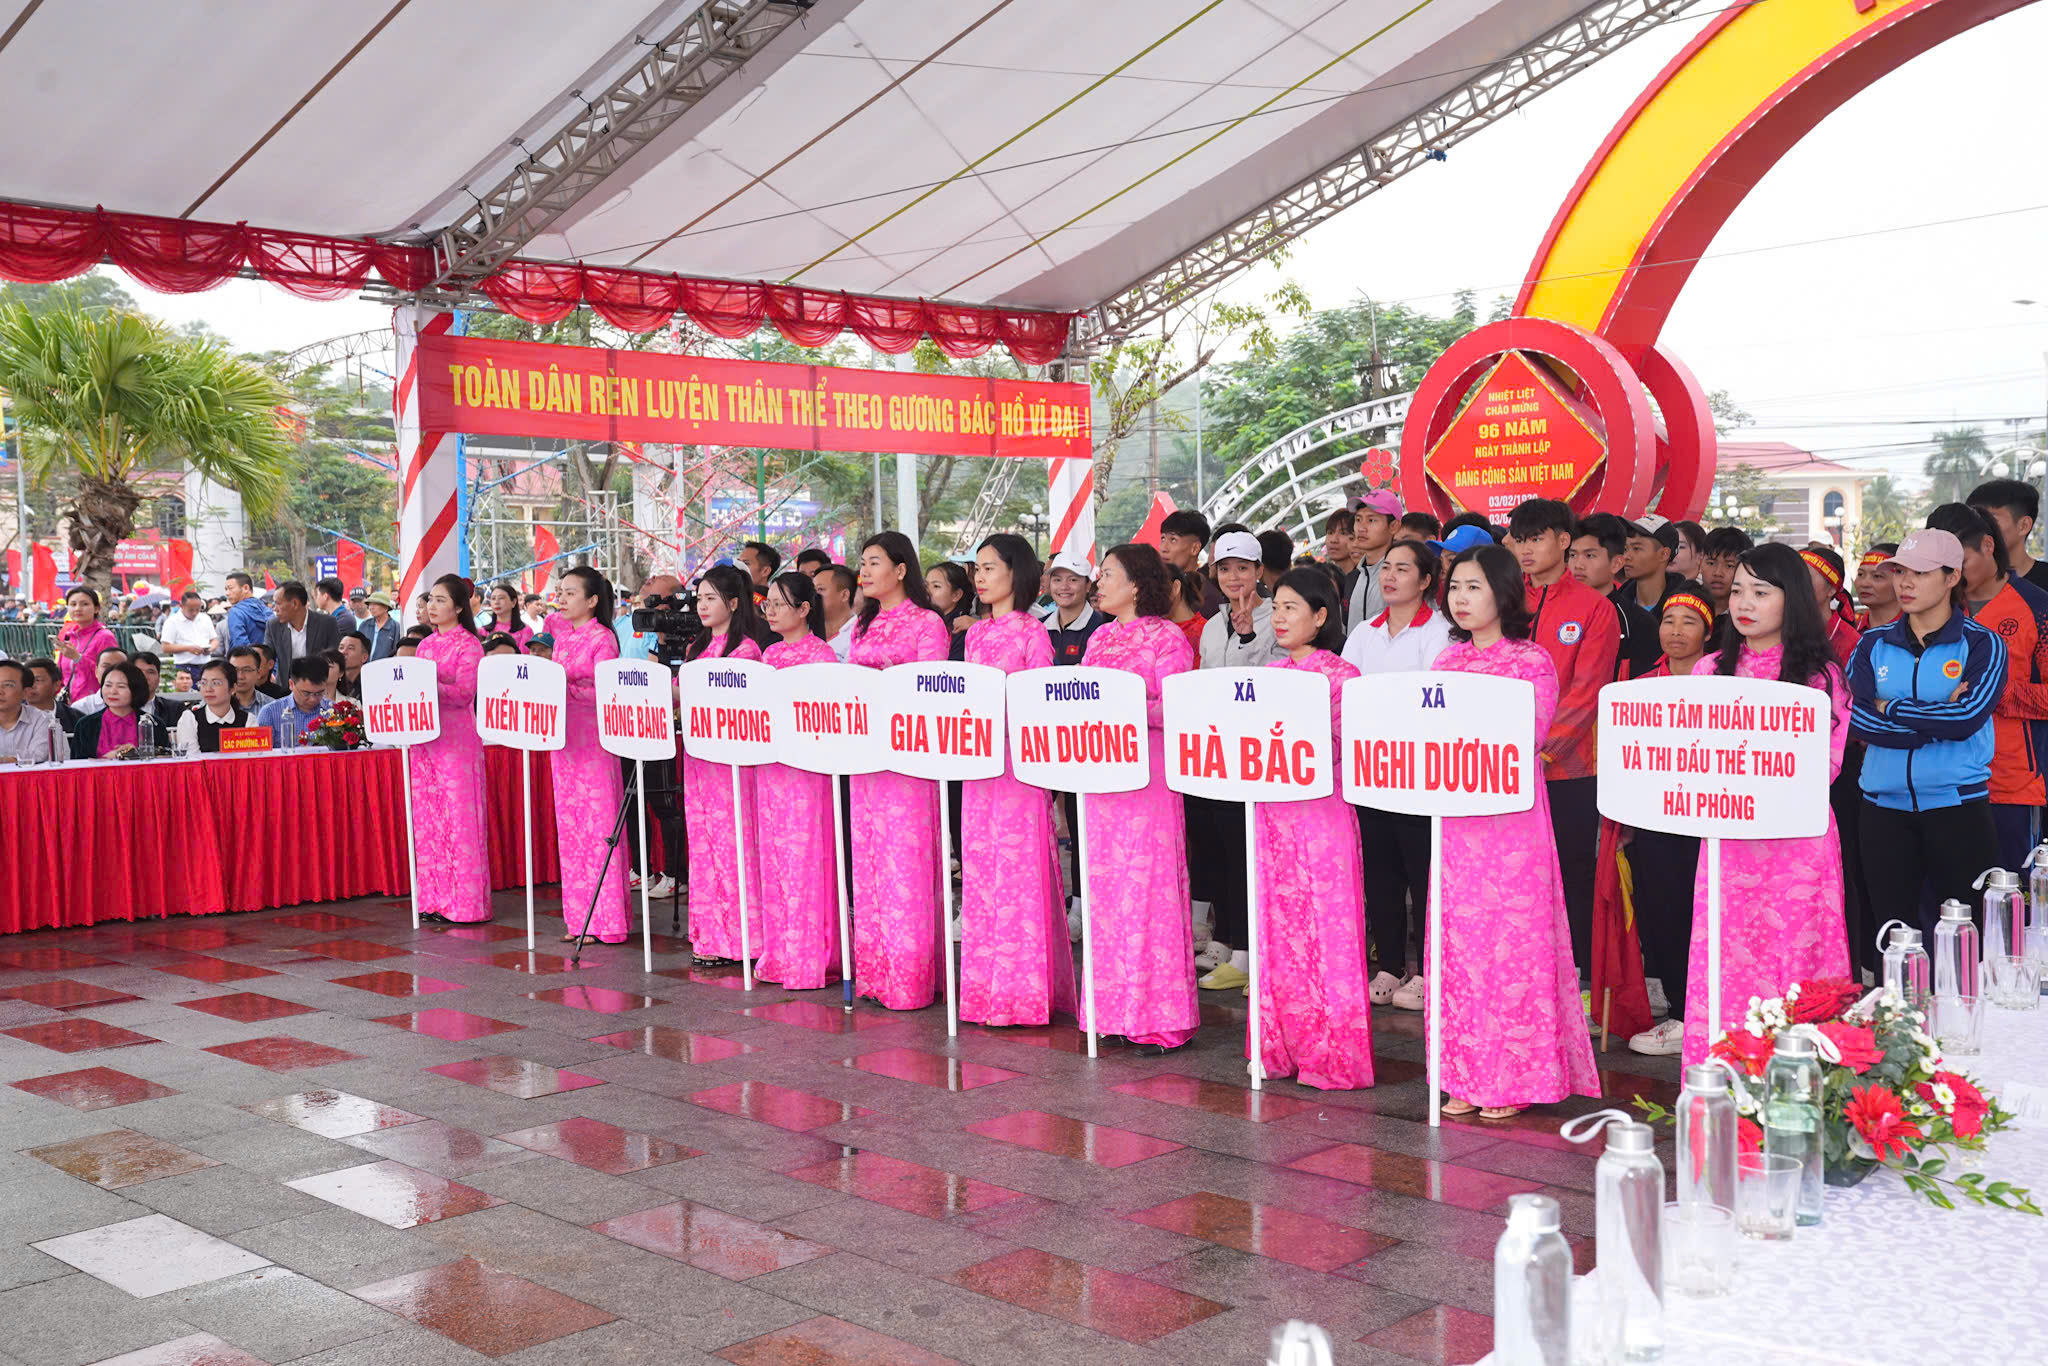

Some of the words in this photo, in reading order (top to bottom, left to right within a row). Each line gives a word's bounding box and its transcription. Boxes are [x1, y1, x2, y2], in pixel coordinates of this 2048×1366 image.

[449, 358, 520, 410] TOÀN
[528, 363, 582, 413] DÂN
[590, 369, 639, 417] RÈN
[646, 374, 720, 429] LUYỆN
[725, 379, 783, 424] THÂN
[788, 375, 829, 428] THỂ
[832, 391, 883, 430] THEO
[889, 393, 954, 434] GƯƠNG
[959, 394, 996, 436] BÁC
[1001, 391, 1025, 437] HỒ
[1029, 394, 1047, 438] VĨ
[1050, 404, 1079, 446] ĐẠI
[1485, 401, 1511, 416] CHÀO
[1512, 401, 1539, 414] MỪNG
[1488, 390, 1515, 403] NHIỆT
[1517, 388, 1536, 402] LIỆT
[1478, 424, 1500, 440] 96
[1505, 418, 1547, 436] NĂM
[1475, 442, 1500, 458] NGÀY
[1501, 441, 1531, 457] THÀNH
[1532, 441, 1551, 456] LẬP
[1455, 464, 1479, 488] ĐẢNG
[1481, 467, 1506, 488] CỘNG
[1508, 460, 1528, 484] SẢN
[1530, 464, 1549, 485] VIỆT
[1551, 462, 1574, 481] NAM
[393, 664, 404, 681] XÃ
[516, 663, 529, 680] XÃ
[618, 667, 648, 687] PHƯỜNG
[708, 668, 747, 689] PHƯỜNG
[917, 671, 966, 694] PHƯỜNG
[1045, 677, 1100, 701] PHƯỜNG
[1234, 679, 1256, 702] XÃ
[1421, 683, 1446, 709] XÃ
[369, 694, 405, 734] KIẾN
[407, 691, 435, 732] HẢI
[485, 688, 519, 732] KIẾN
[523, 701, 558, 743] THỤY
[603, 693, 634, 737] HỒNG
[636, 698, 668, 740] BÀNG
[690, 705, 712, 739] AN
[717, 707, 771, 743] PHONG
[793, 700, 842, 741] TRỌNG
[844, 696, 868, 736] TÀI
[1611, 701, 1663, 728] TRUNG
[1667, 698, 1703, 729] TÂM
[1708, 695, 1755, 731] HUẤN
[1760, 701, 1816, 739] LUYỆN
[223, 739, 235, 749] CÁC
[260, 735, 269, 747] XÃ
[890, 712, 929, 753] GIA
[936, 708, 993, 758] VIÊN
[1021, 725, 1049, 763] AN
[1056, 720, 1139, 763] DƯƠNG
[1178, 725, 1228, 780] HÀ
[1239, 720, 1316, 787] BẮC
[1353, 739, 1416, 790] NGHI
[1424, 736, 1520, 795] DƯƠNG
[1622, 740, 1642, 770] VÀ
[1647, 745, 1672, 772] THI
[1676, 738, 1711, 774] ĐẤU
[1715, 738, 1747, 776] THỂ
[1751, 750, 1796, 778] THAO
[1663, 782, 1691, 817] HẢI
[1696, 787, 1755, 821] PHÒNG
